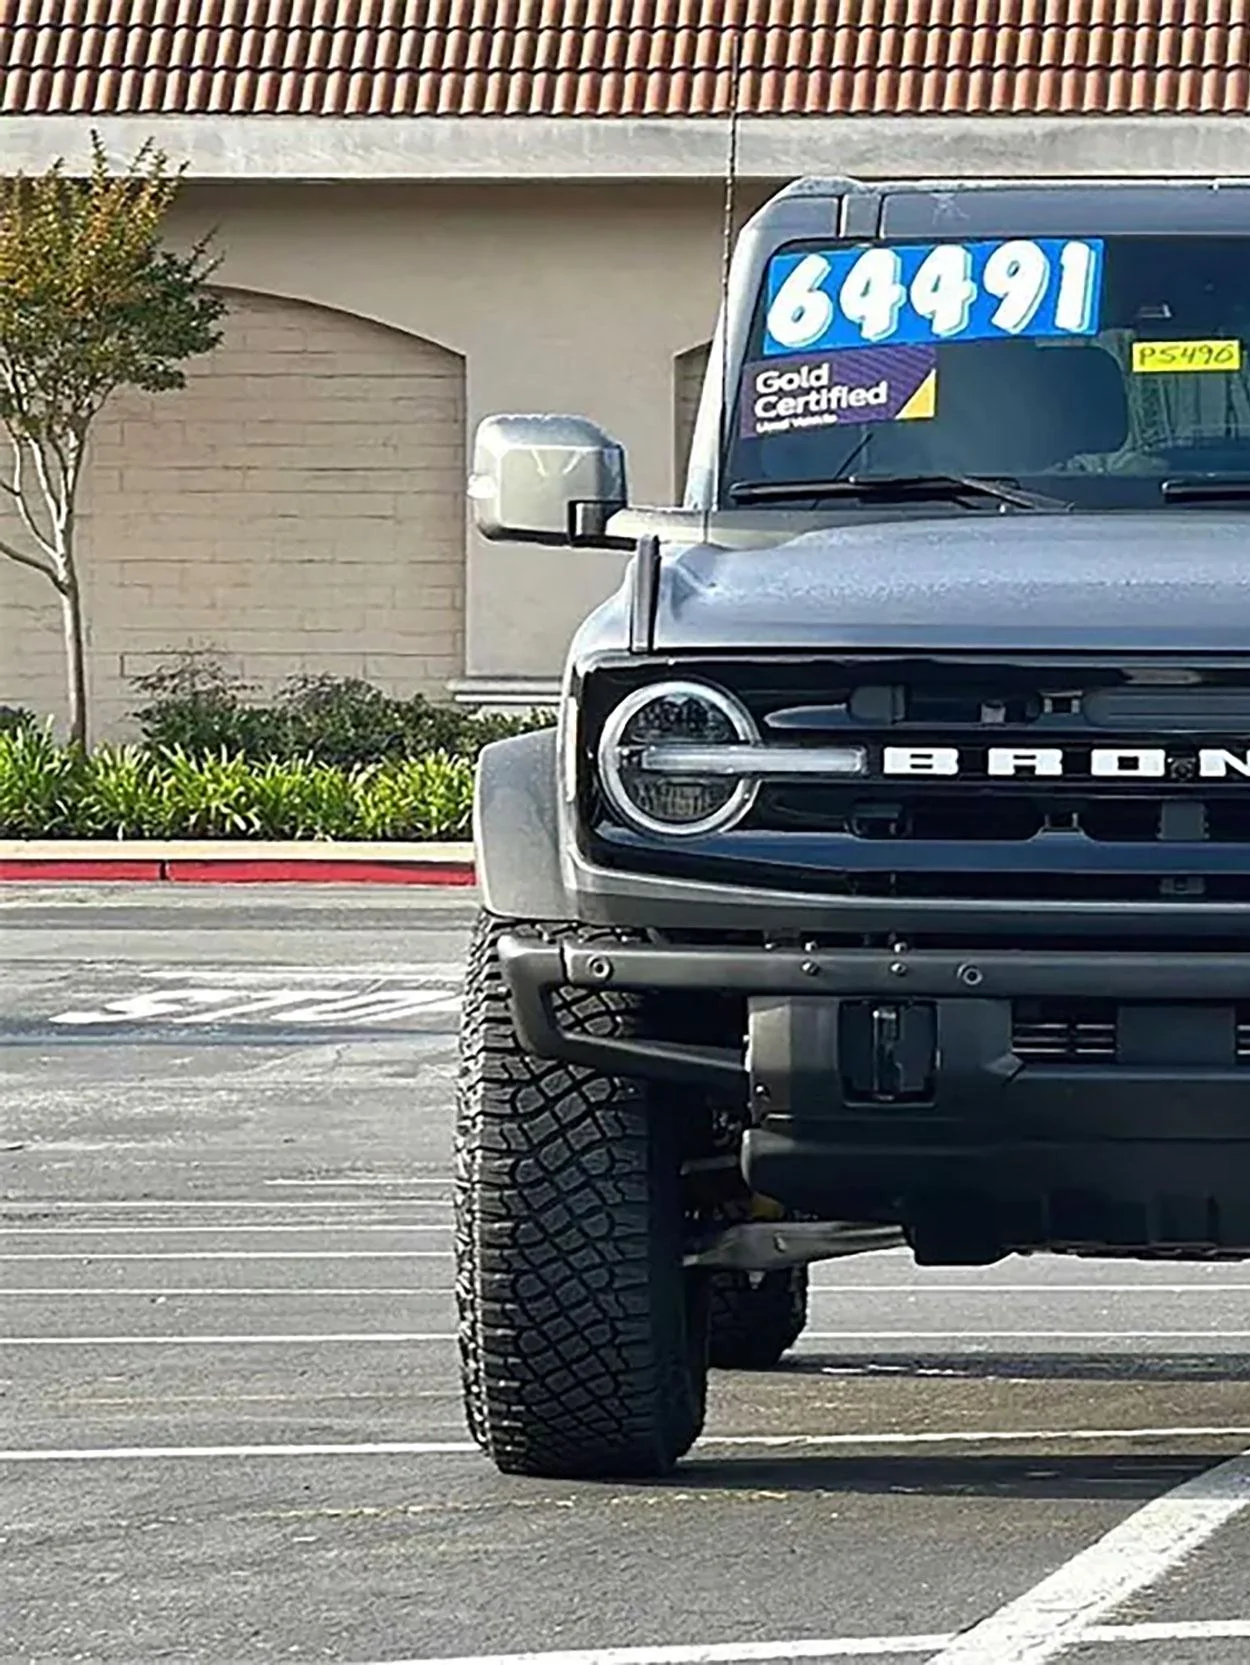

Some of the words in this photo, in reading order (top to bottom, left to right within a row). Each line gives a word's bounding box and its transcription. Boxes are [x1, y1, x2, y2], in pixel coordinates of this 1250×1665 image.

[767, 239, 1095, 349] 64491
[755, 362, 830, 394] Gold
[754, 380, 889, 418] Certified
